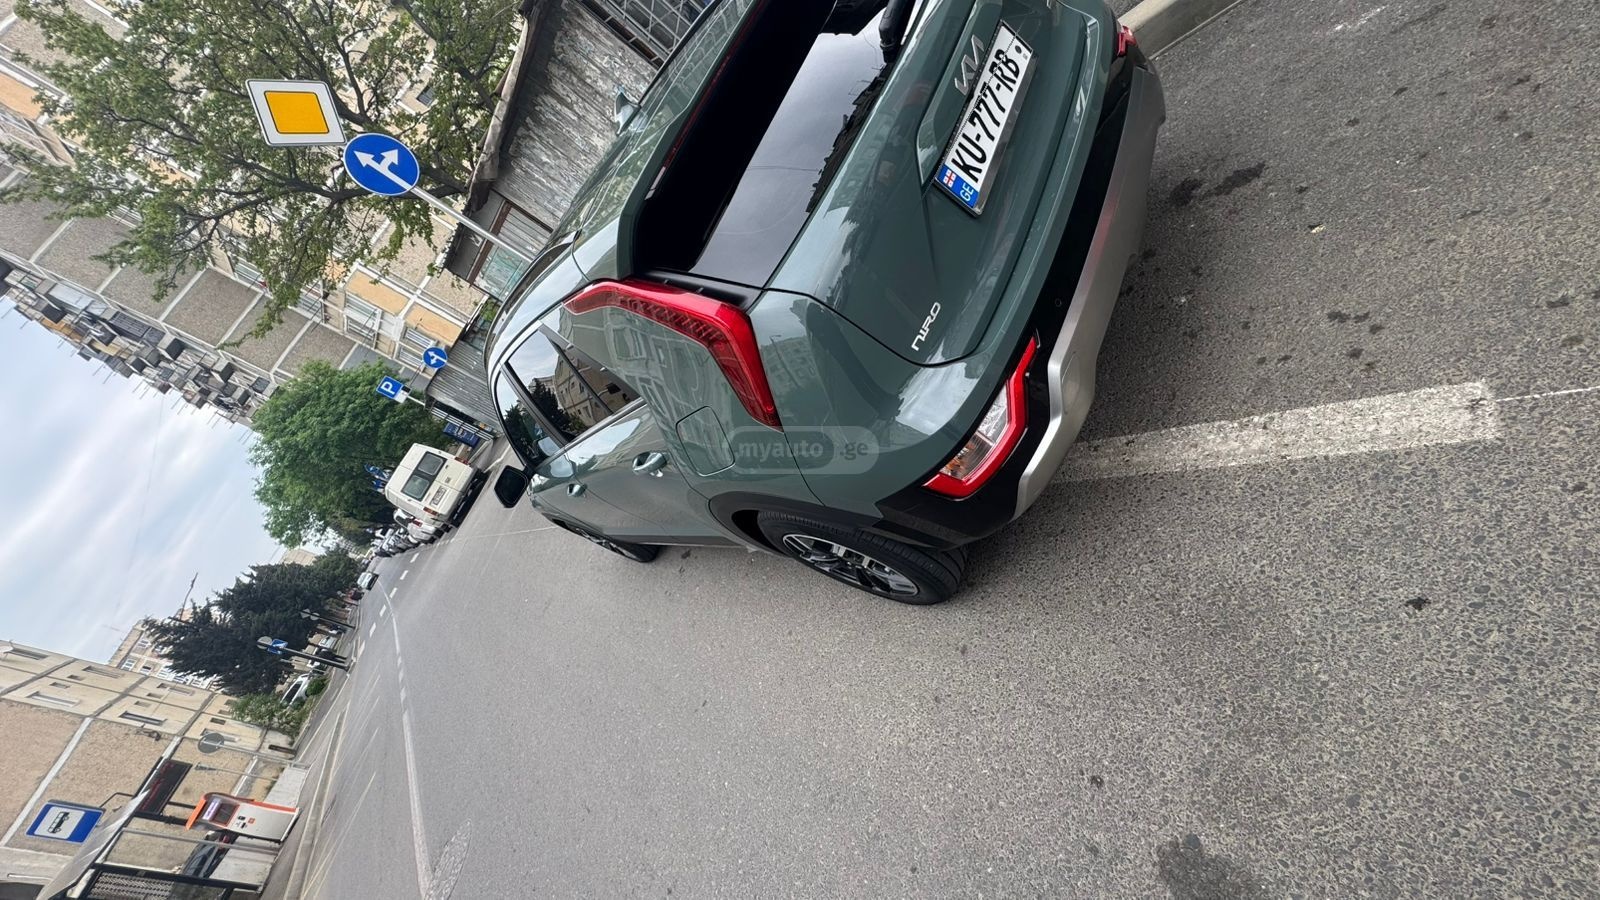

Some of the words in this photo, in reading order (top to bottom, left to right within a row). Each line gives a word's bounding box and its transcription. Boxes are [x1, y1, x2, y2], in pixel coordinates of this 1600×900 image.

[950, 48, 1021, 184] KU-777-RB
[959, 181, 975, 203] GE
[380, 381, 396, 395] P
